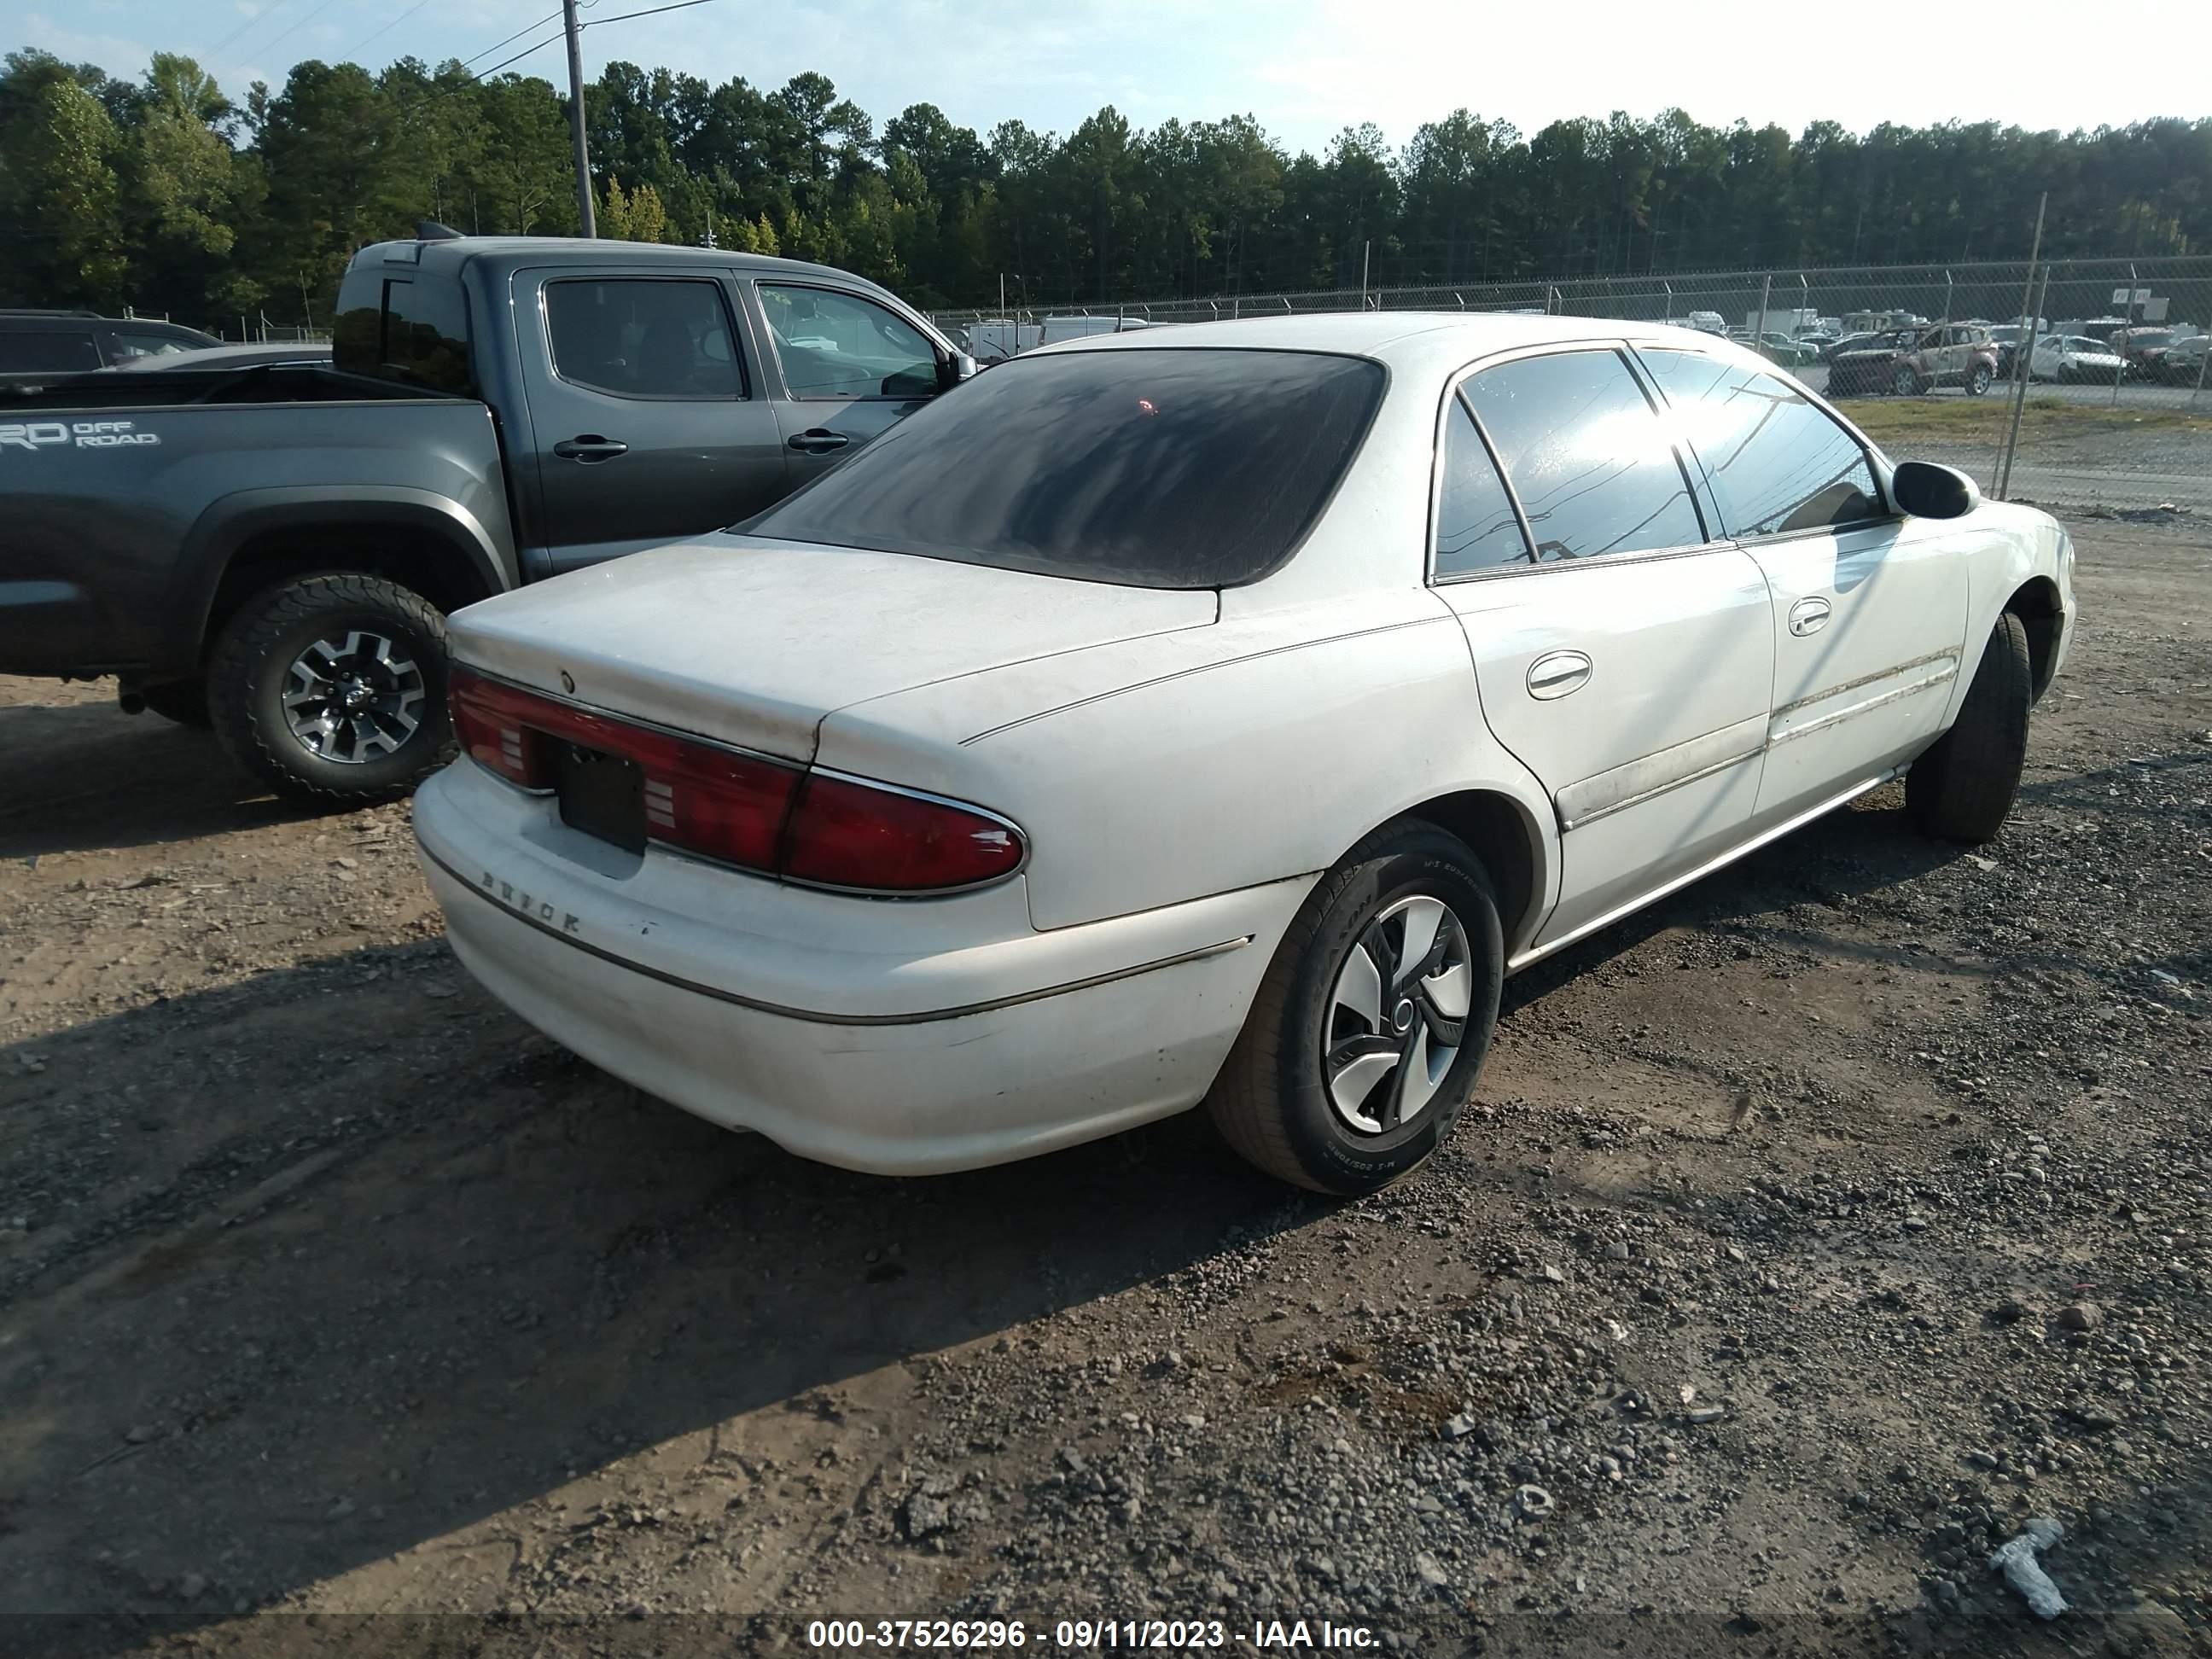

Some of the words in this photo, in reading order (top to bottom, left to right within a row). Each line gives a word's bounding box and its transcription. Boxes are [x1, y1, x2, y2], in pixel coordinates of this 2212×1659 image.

[72, 422, 132, 434] OFF
[74, 434, 160, 447] ROAD
[482, 871, 580, 932] BUICK
